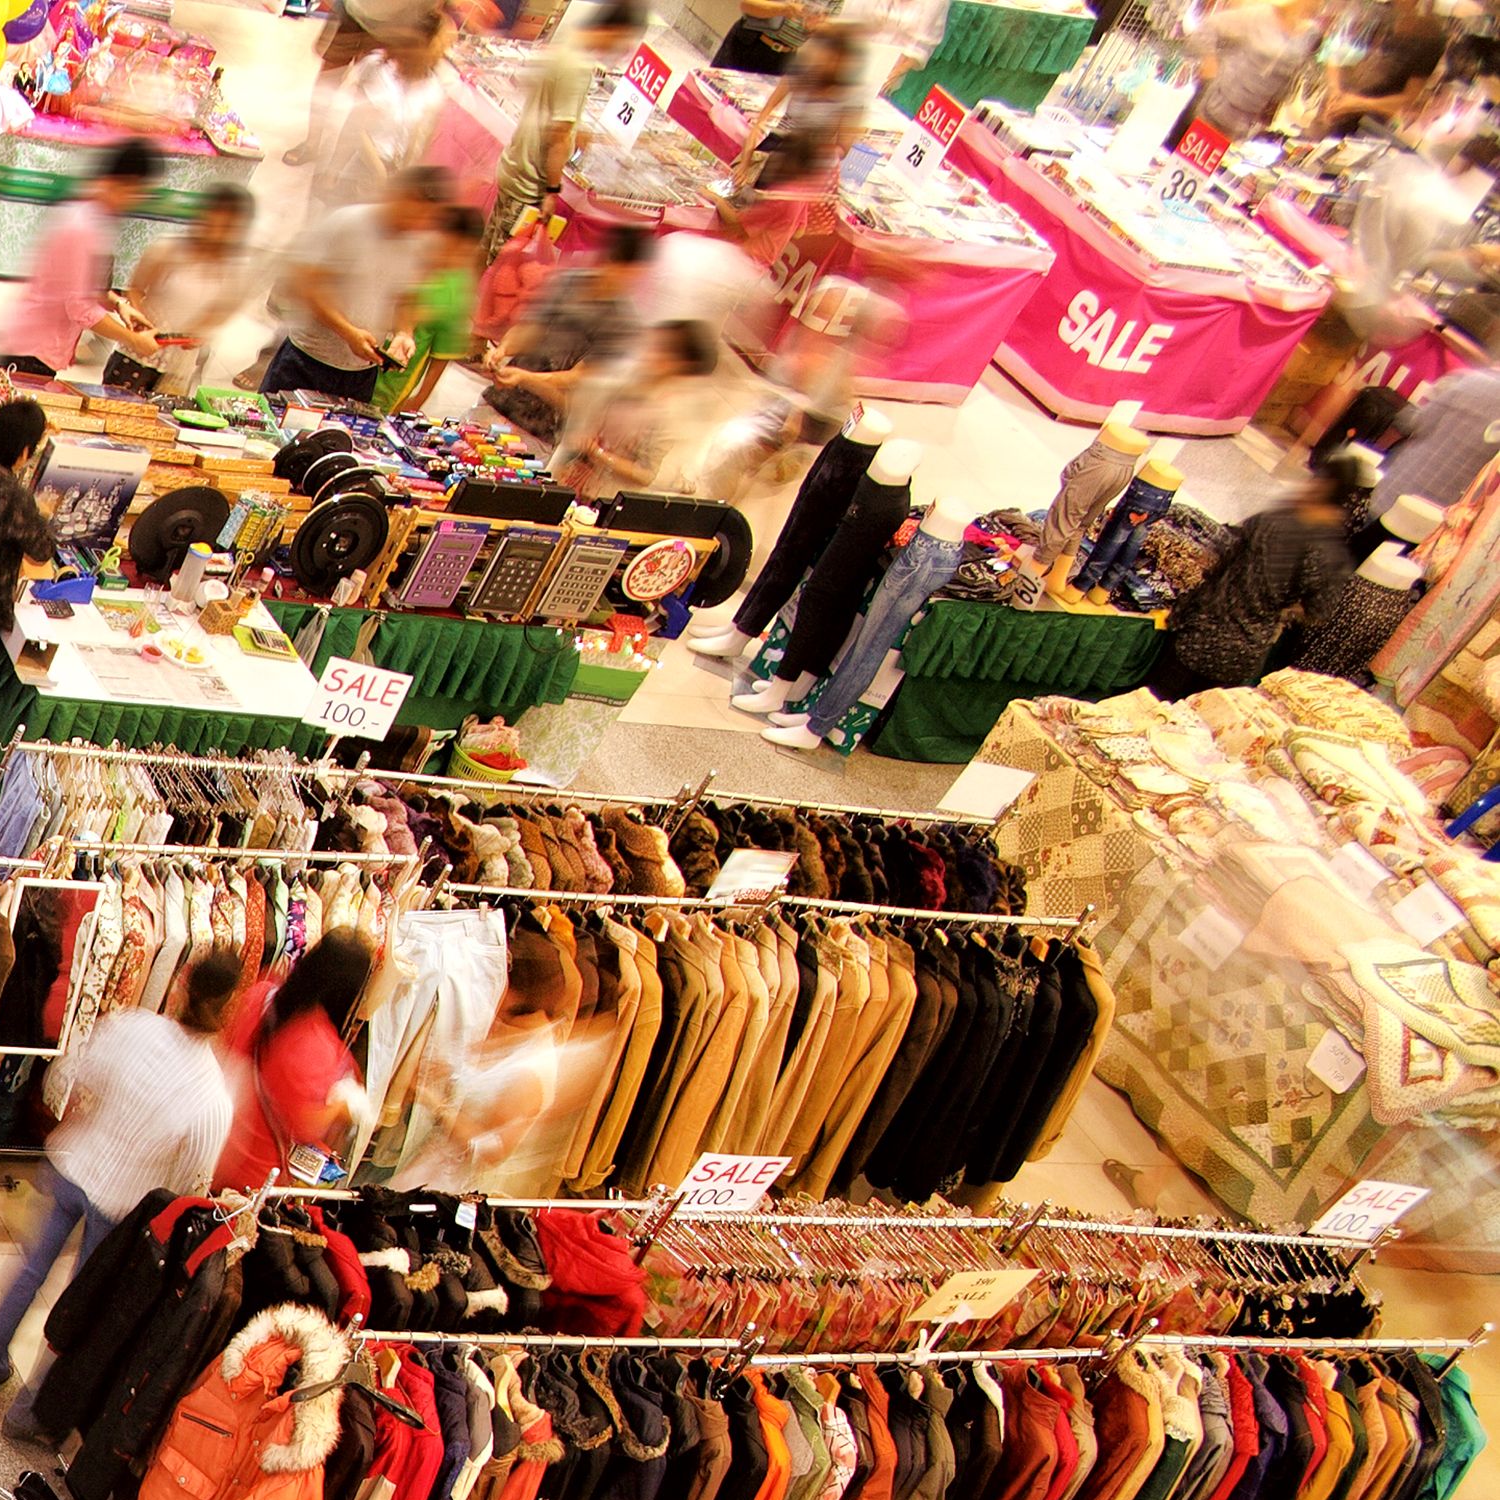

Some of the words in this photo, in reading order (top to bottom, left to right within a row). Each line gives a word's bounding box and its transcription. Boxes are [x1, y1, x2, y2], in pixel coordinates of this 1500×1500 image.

[628, 55, 665, 100] SALE
[617, 101, 635, 125] 25
[919, 100, 957, 142] SALE
[906, 144, 926, 167] 25
[1180, 132, 1223, 172] SALE
[1058, 290, 1175, 374] SALE
[324, 668, 404, 707] SALE
[319, 700, 380, 730] 100.-
[692, 1162, 782, 1184] SALE
[683, 1188, 747, 1206] 100.-
[1342, 1187, 1417, 1211] SALE
[1322, 1211, 1384, 1234] 100.-
[951, 1291, 992, 1301] SALE
